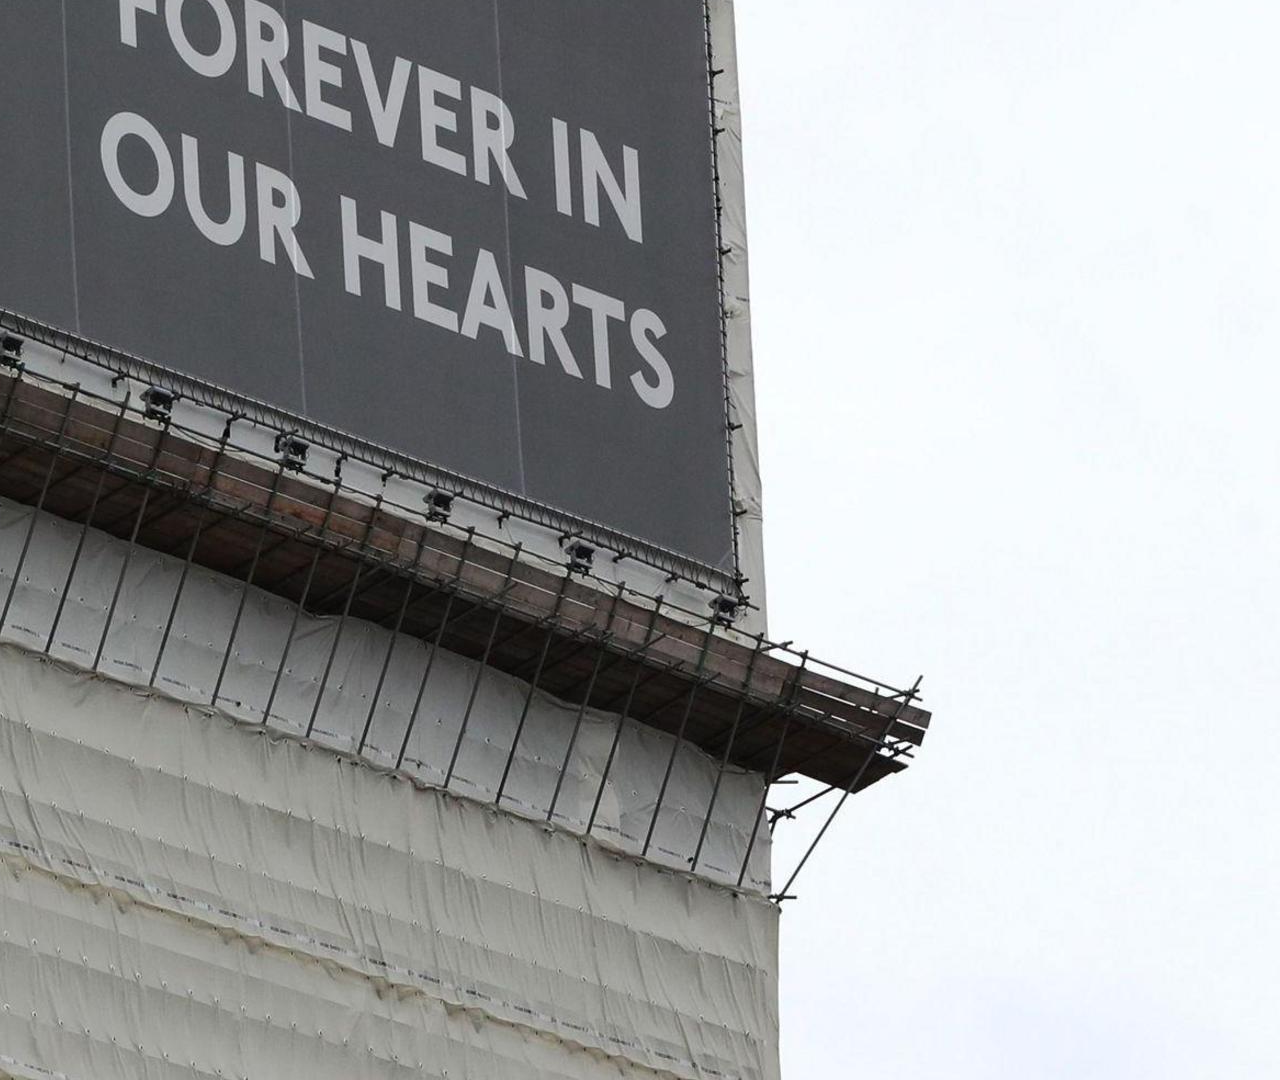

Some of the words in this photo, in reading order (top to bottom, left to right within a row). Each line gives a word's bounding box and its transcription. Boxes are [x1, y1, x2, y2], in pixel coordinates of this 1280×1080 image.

[100, 111, 314, 280] OUR
[340, 194, 675, 410] HEARTS
[552, 117, 643, 244] IN
